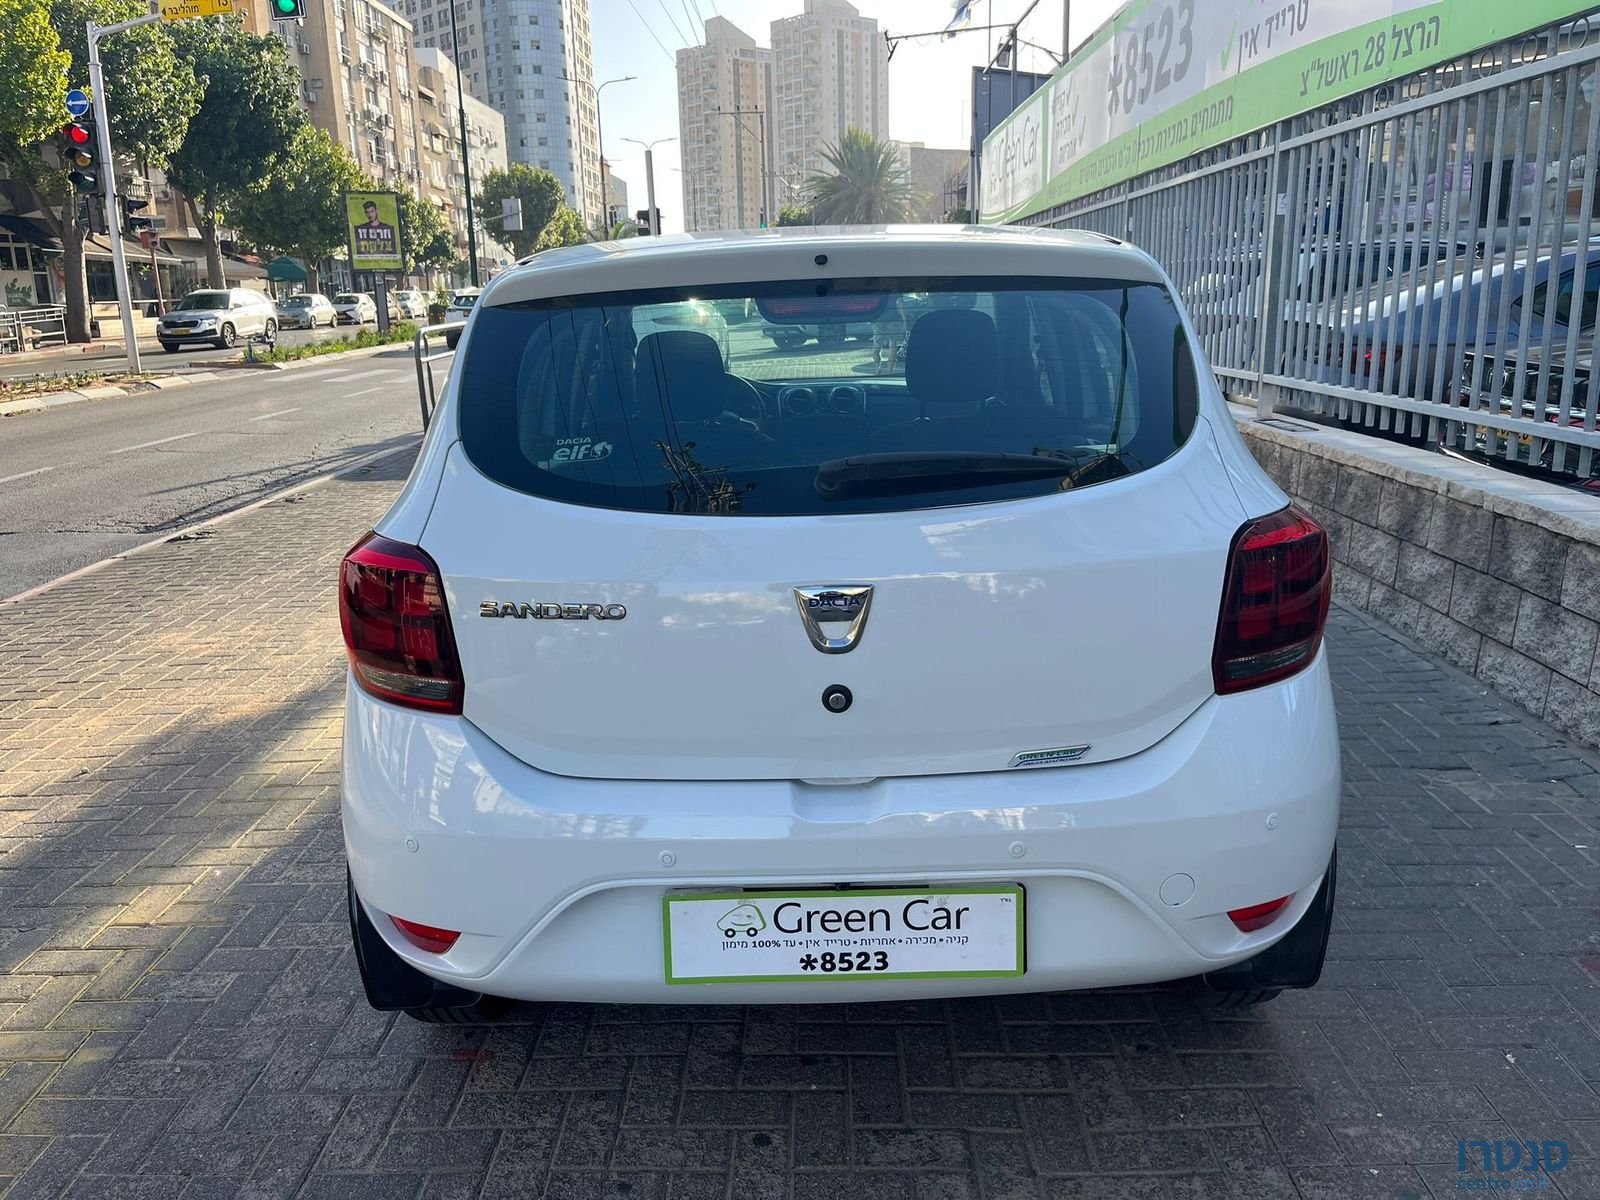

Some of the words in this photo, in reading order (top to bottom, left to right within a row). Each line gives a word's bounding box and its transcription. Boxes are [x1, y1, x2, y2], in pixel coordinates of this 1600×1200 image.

[1265, 0, 1309, 49] טרייד
[1392, 15, 1441, 61] הרצל
[1238, 23, 1261, 74] אין
[1363, 31, 1387, 73] 28
[1191, 94, 1233, 138] מתמחים
[1023, 115, 1040, 168] Car
[1155, 117, 1188, 154] במכירת
[556, 437, 592, 446] DACIA
[553, 444, 592, 461] elf
[808, 597, 861, 608] DACIA
[480, 600, 627, 621] SANDERO
[773, 902, 891, 934] Green
[902, 899, 970, 931] Car
[721, 941, 749, 951] מימון
[752, 940, 781, 949] 100%
[783, 940, 797, 948] עד
[805, 940, 821, 949] אין
[824, 939, 851, 947] טרייד
[859, 938, 897, 947] אחריות
[905, 936, 937, 945] מכירה
[945, 935, 969, 946] קניה
